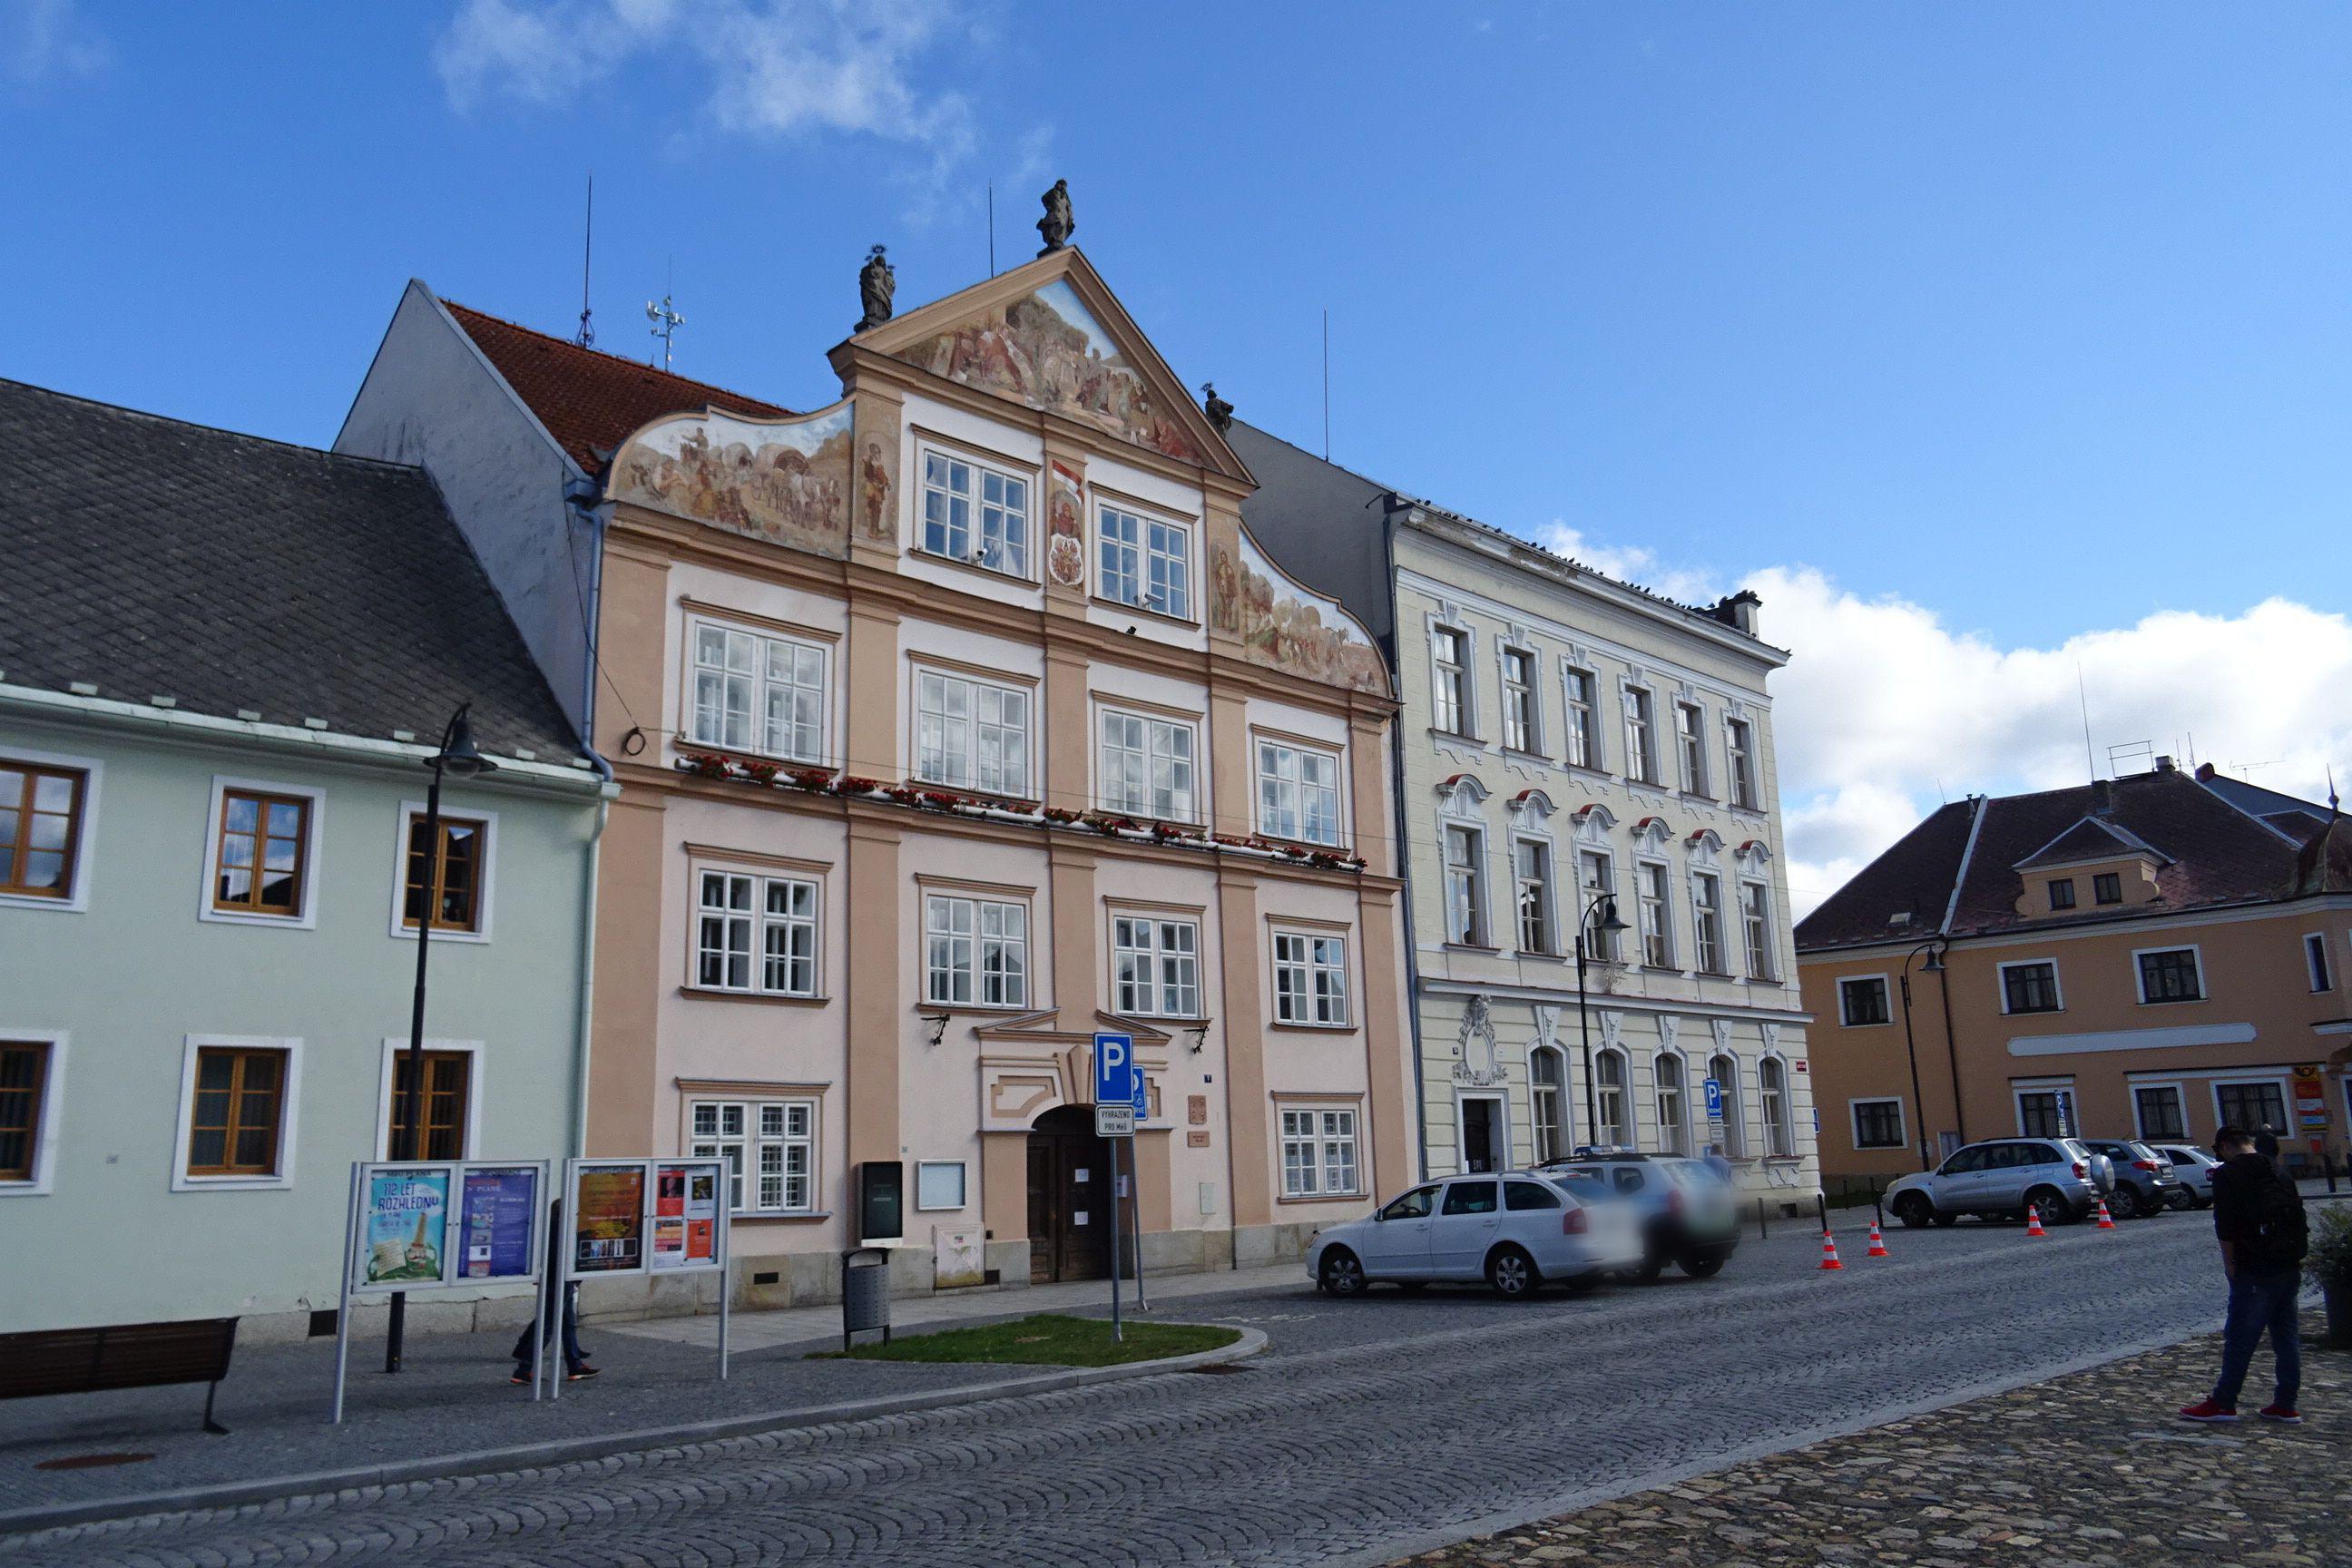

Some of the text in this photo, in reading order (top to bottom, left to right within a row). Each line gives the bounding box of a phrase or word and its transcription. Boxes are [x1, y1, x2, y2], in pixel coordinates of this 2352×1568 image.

[1103, 1043, 1124, 1081] P
[1708, 1085, 1717, 1105] P
[1102, 1110, 1130, 1118] VYHRAZENO
[1104, 1122, 1114, 1131] PRO
[384, 1182, 416, 1196] 112 LET
